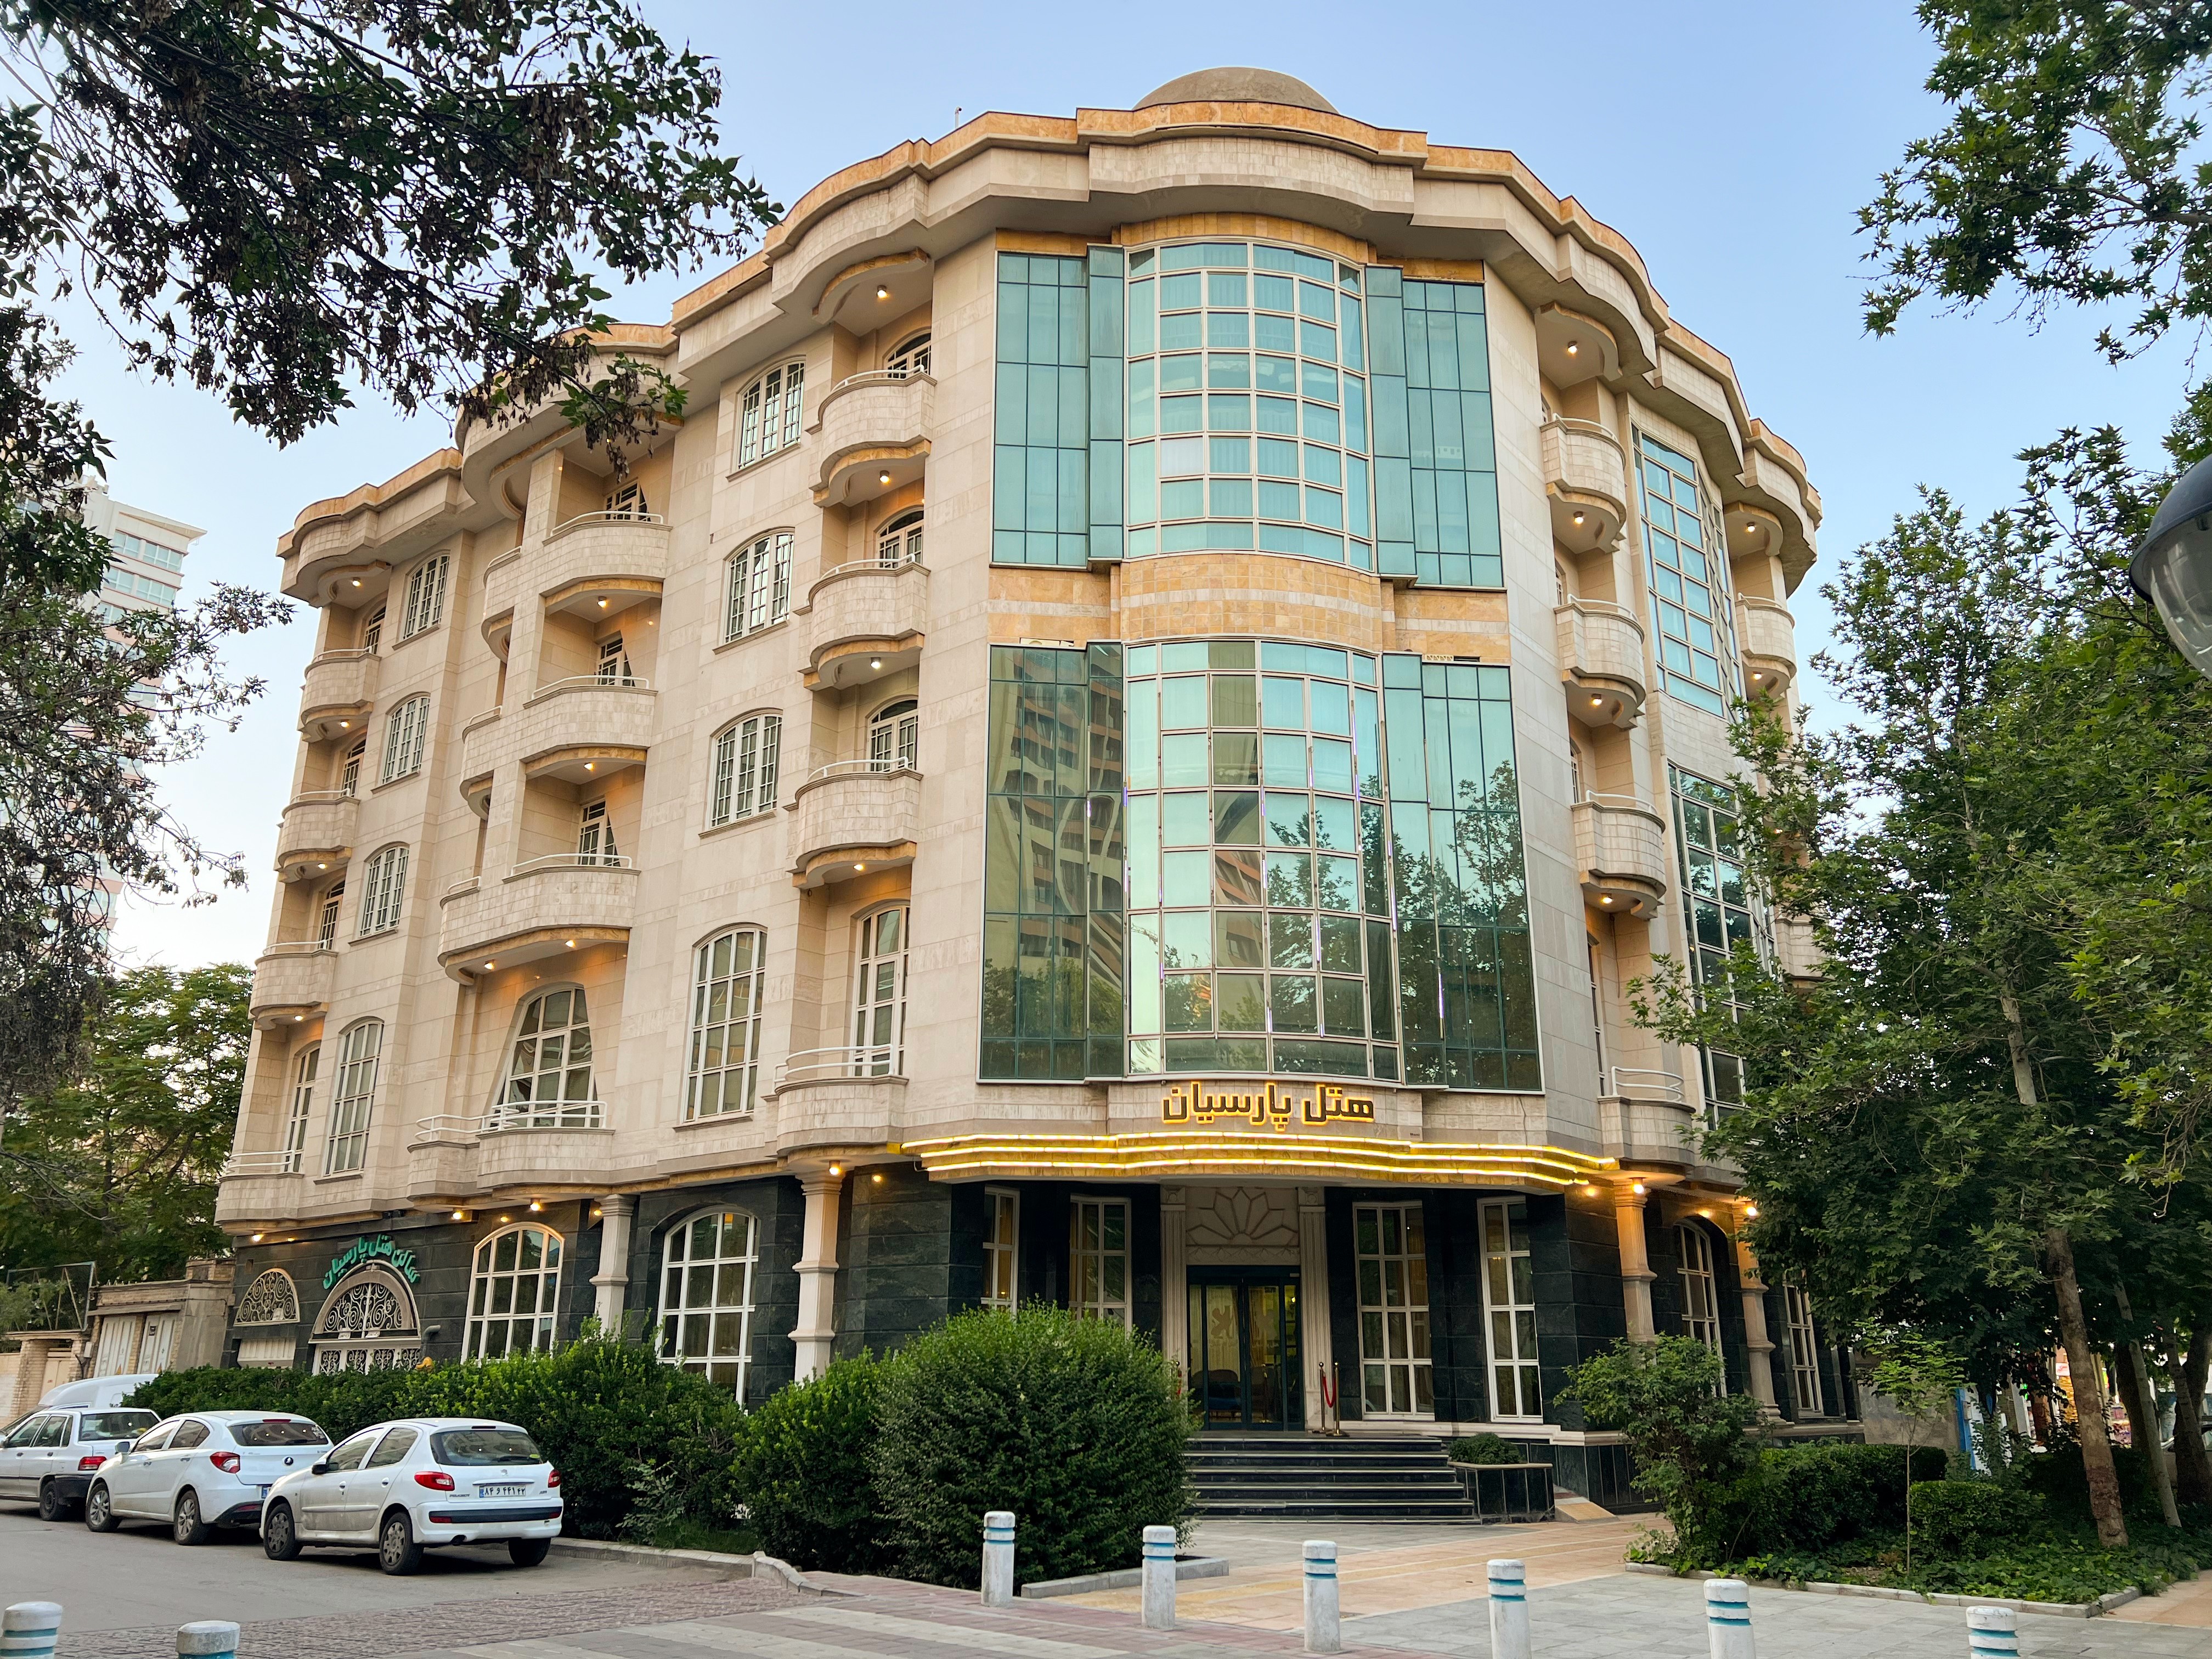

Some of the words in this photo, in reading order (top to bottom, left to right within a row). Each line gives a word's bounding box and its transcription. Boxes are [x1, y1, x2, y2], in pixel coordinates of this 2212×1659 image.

[1162, 1081, 1291, 1131] پارسیان
[1302, 1084, 1374, 1125] هتل
[323, 1237, 369, 1289] پارسیان
[368, 1234, 394, 1256] هتل
[392, 1249, 420, 1283] سالن
